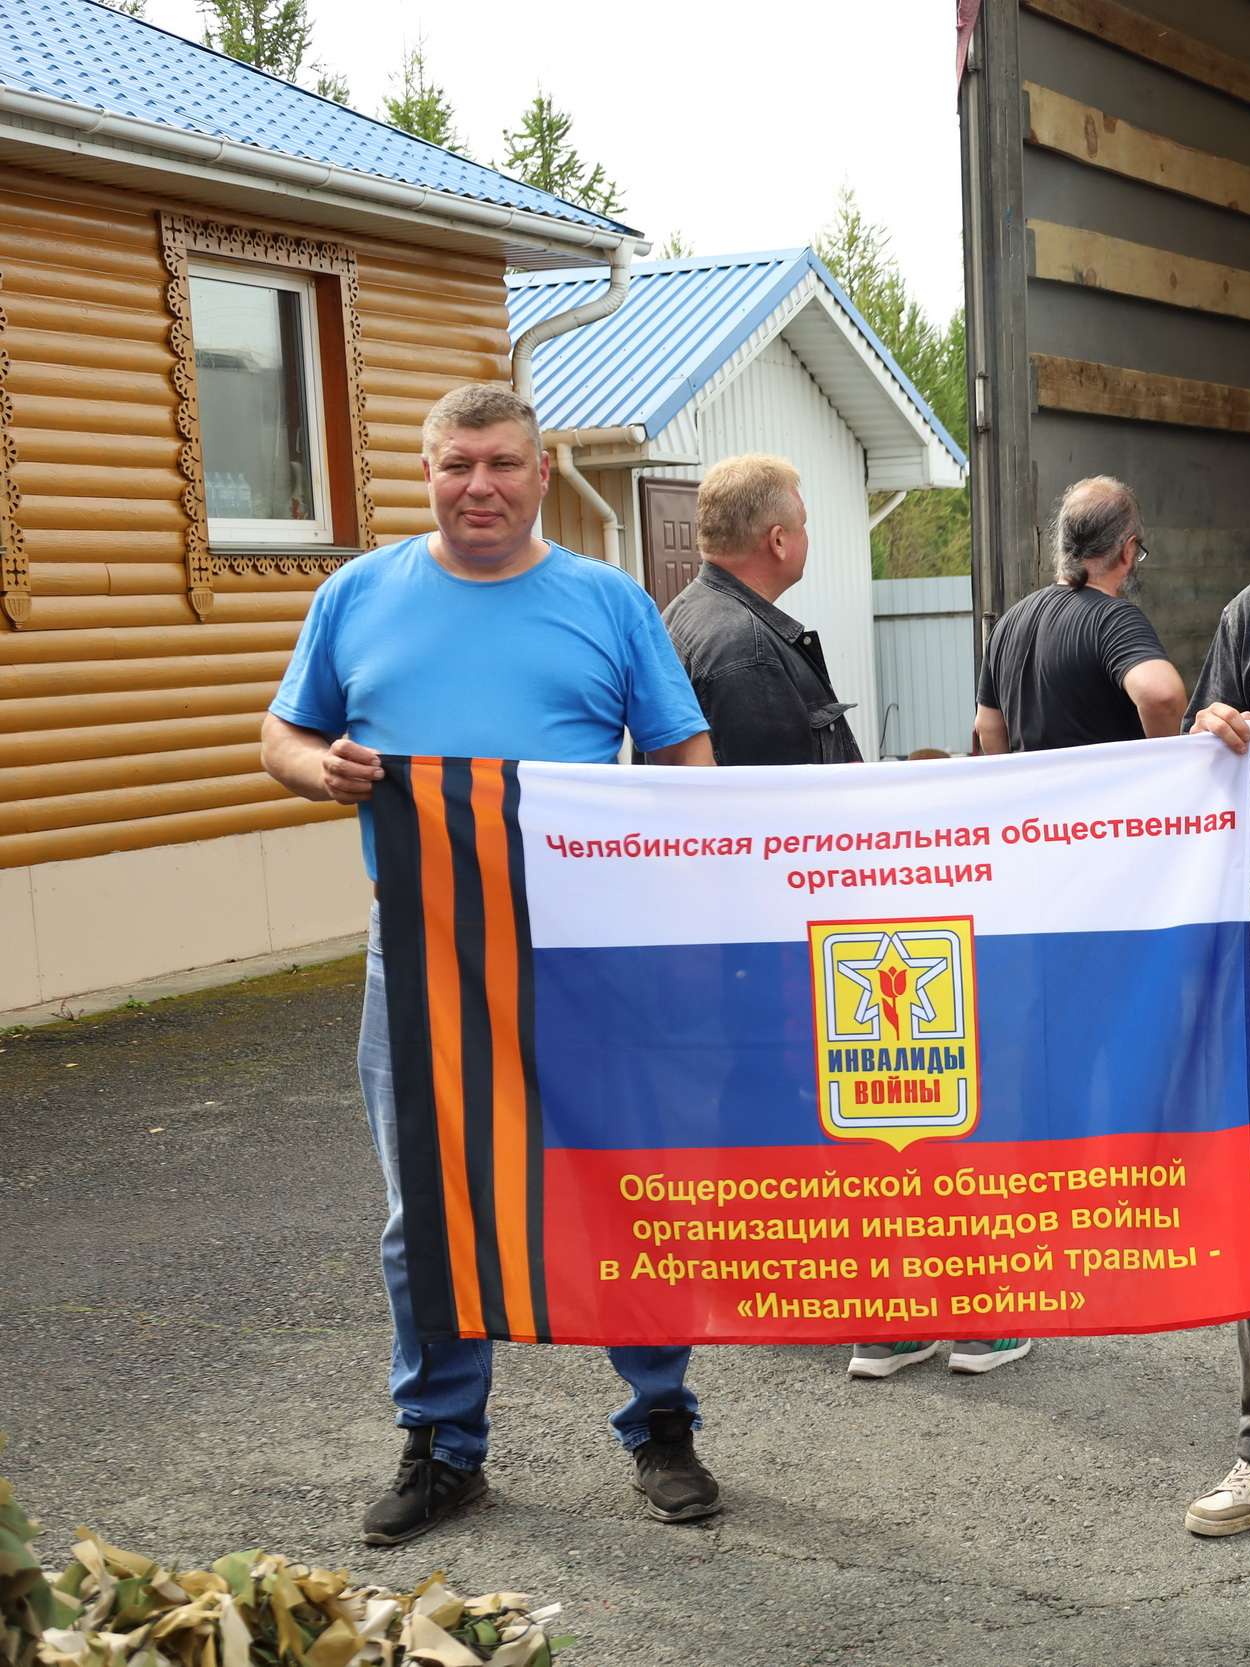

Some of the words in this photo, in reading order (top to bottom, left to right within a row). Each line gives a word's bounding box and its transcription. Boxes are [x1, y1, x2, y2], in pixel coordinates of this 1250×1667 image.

[546, 832, 753, 860] Челябинская
[763, 826, 991, 860] региональная
[1001, 808, 1237, 845] общественная
[786, 861, 993, 892] организация
[828, 1046, 966, 1074] ИНВАЛИДЫ
[853, 1075, 942, 1105] ВОЙНЫ
[619, 1170, 922, 1206] Общероссийской
[933, 1158, 1187, 1200] общественной
[632, 1217, 850, 1246] организации
[862, 1210, 1059, 1240] инвалидов
[1071, 1200, 1181, 1230] войны
[600, 1260, 620, 1281] в
[630, 1252, 858, 1285] Афганистане
[870, 1257, 890, 1279] и
[902, 1245, 1054, 1278] военной
[1063, 1246, 1197, 1276] травмы
[737, 1291, 938, 1321] «Инвалиды
[950, 1285, 1086, 1317] войны»
